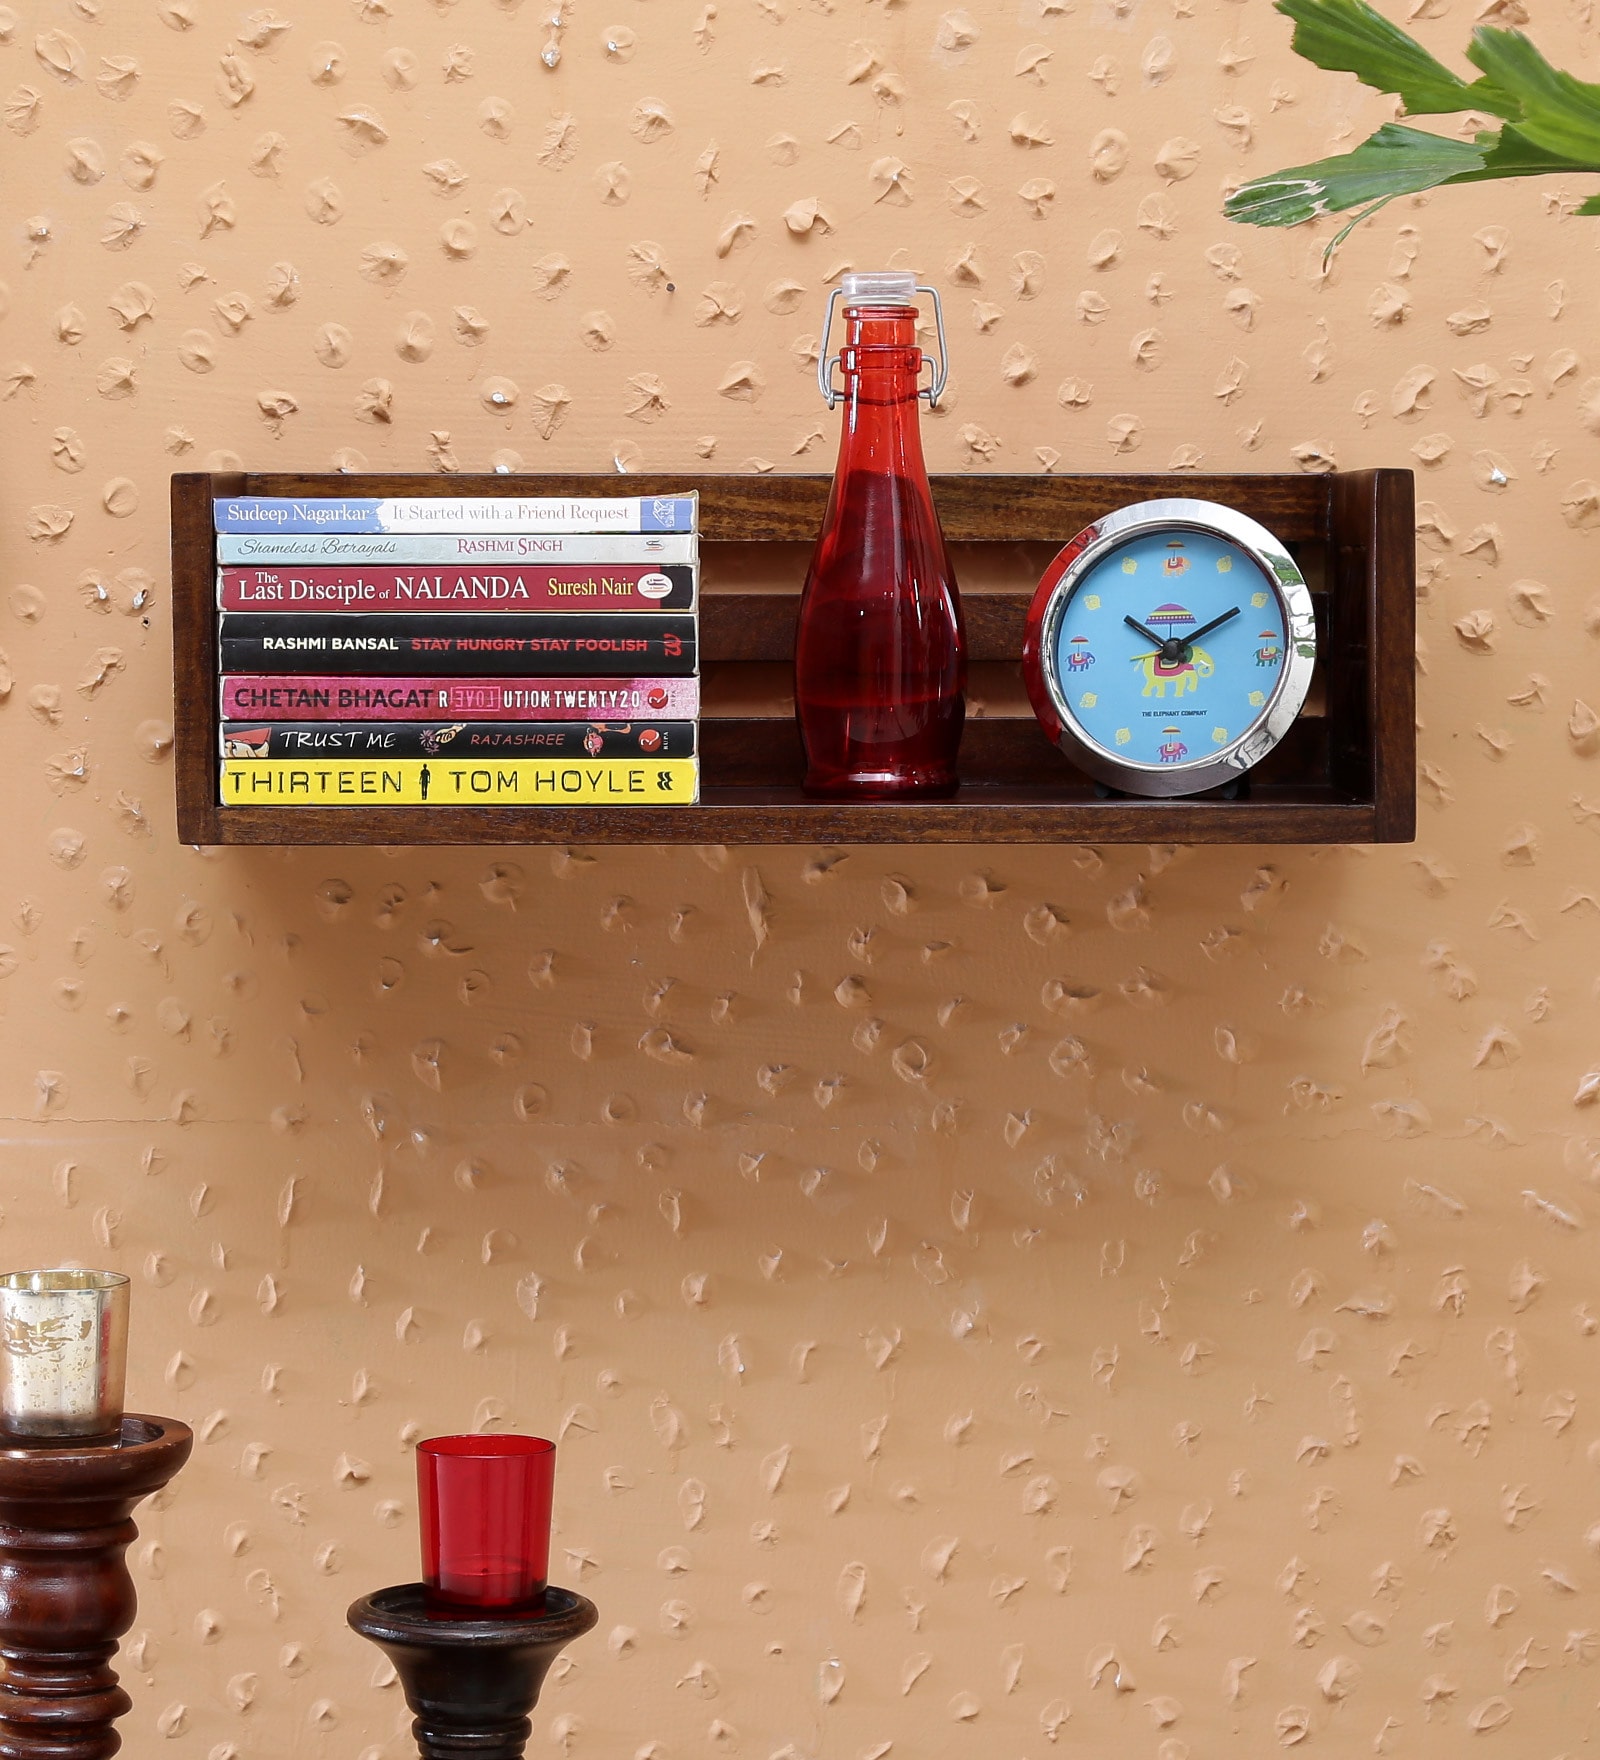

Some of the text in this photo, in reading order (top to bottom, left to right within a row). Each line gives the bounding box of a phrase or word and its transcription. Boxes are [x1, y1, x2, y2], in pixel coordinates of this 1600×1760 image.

[227, 504, 369, 524] Sudeep Nagarkar
[393, 505, 629, 522] It Started with a Friend Request
[237, 538, 397, 557] Shameless Betrayals
[457, 538, 563, 555] RASHMI SINGH
[255, 572, 278, 584] The
[548, 577, 633, 596] Suresh Nair
[239, 576, 529, 605] Last Disciple of NALANDA
[263, 638, 399, 650] RASHMI BANSAL
[411, 638, 648, 651] STAY HUNGRY STAY FOOLISH
[234, 689, 432, 707] CHETAN BHAGAT
[280, 731, 396, 748] TRUST ME
[471, 733, 565, 745] RAJASHREE
[228, 771, 402, 793] THIRTEEN
[449, 770, 645, 793] TOM HOYLE
